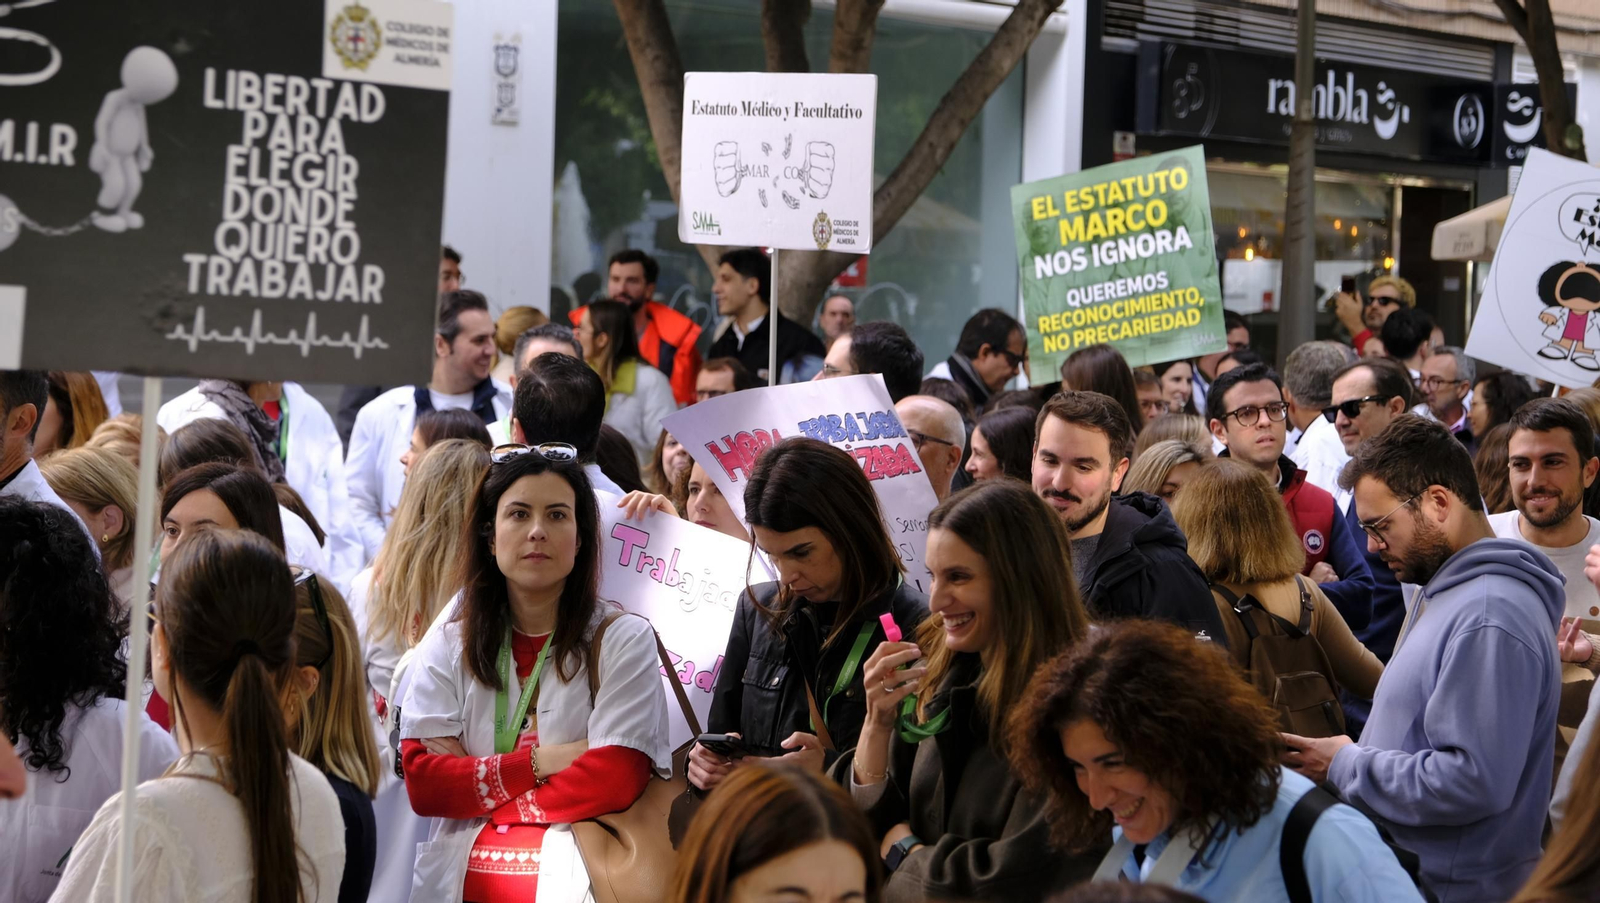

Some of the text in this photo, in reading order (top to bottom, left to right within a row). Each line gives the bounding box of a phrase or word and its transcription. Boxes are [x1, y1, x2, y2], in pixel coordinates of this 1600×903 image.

[385, 21, 449, 38] COLEGIO DE
[436, 41, 450, 54] DE
[203, 66, 386, 123] LIBERTAD
[691, 99, 863, 121] Estatuto Médico y Facultativo
[243, 110, 346, 156] PARA
[226, 145, 359, 193] ELEGIR
[745, 165, 770, 178] MAR
[223, 183, 358, 230] DONDE
[1031, 167, 1188, 220] EL ESTATUTO
[214, 221, 361, 266] QUIERO
[833, 219, 859, 228] COLEGIO DE
[833, 228, 852, 236] MÉDICOS
[836, 237, 855, 245] ALMERÍA
[1059, 199, 1168, 246] MARCO
[1034, 226, 1193, 279] NOS IGNORA
[183, 253, 385, 304] TRABAJAR
[1066, 271, 1169, 308] QUEREMOS
[1038, 286, 1205, 334] RECONOCIMIENTO,
[1043, 308, 1201, 353] NO PRECARIEDAD
[798, 410, 908, 444] TRABAJADA
